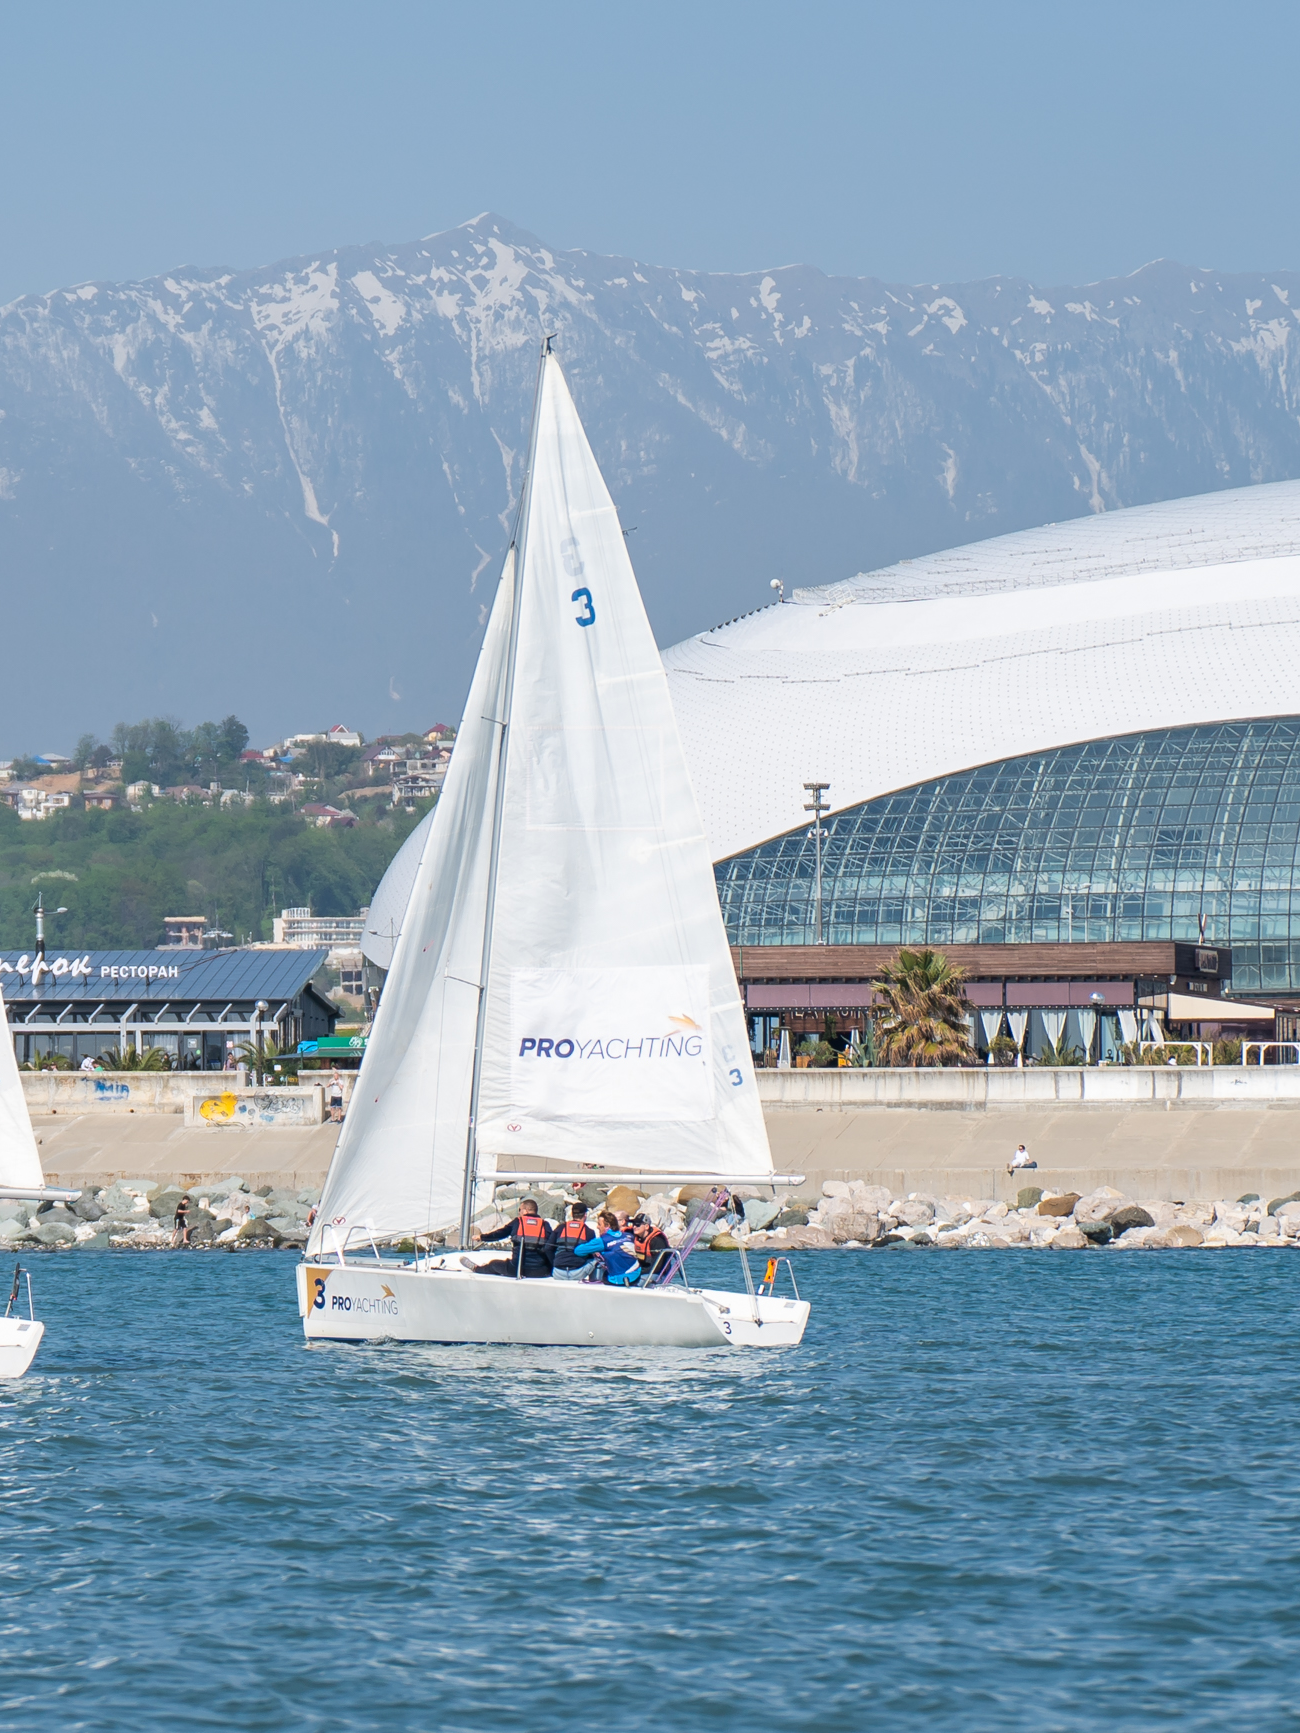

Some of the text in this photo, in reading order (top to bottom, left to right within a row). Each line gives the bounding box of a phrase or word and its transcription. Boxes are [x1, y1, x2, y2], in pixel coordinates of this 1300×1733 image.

[571, 587, 596, 627] 3
[101, 965, 179, 977] РЕСТОРАН
[519, 1036, 702, 1059] PROYACHTING
[729, 1068, 743, 1086] 3
[314, 1278, 326, 1309] 3
[332, 1296, 398, 1315] PROYACHTING
[723, 1321, 732, 1335] 3
